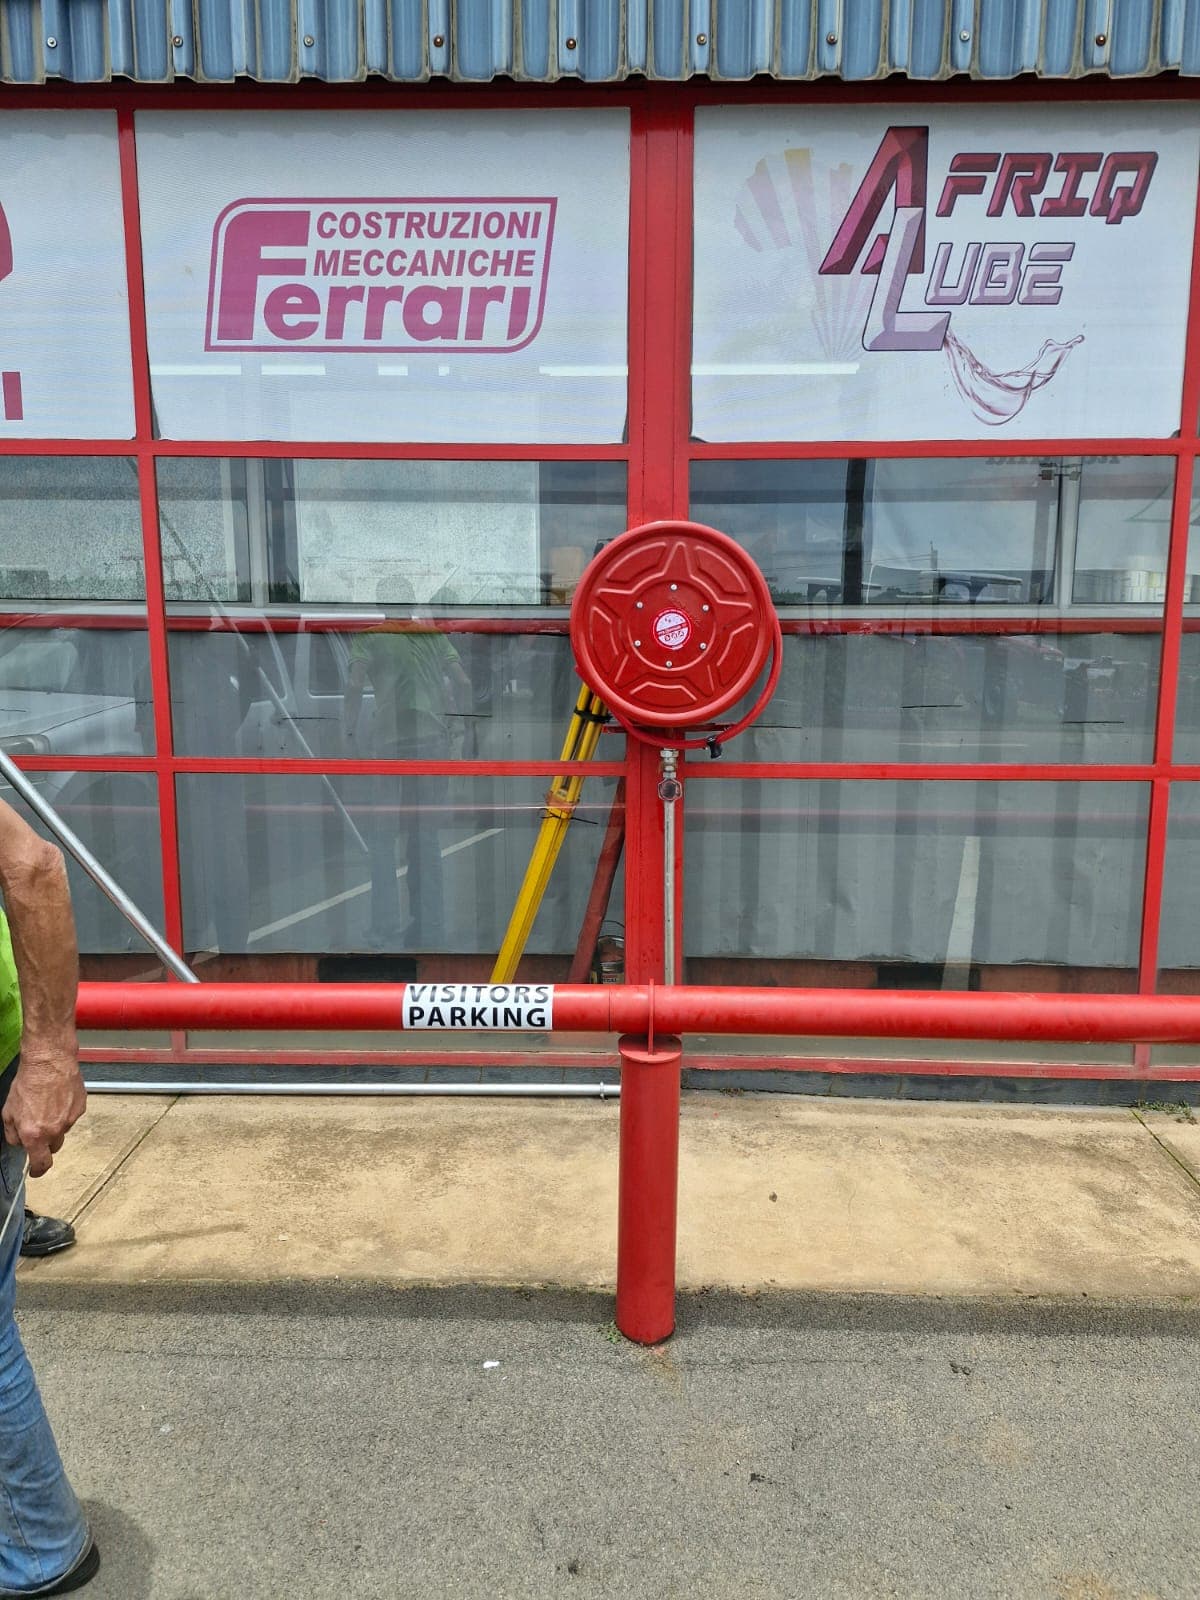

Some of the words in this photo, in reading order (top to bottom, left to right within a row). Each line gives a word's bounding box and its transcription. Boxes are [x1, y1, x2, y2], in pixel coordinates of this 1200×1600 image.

[819, 126, 1158, 275] AFRIQ
[316, 211, 542, 239] COSTRUZIONI
[217, 211, 531, 341] Ferrari
[313, 249, 534, 276] MECCANICHE
[862, 207, 1075, 351] LUBE
[409, 985, 549, 1004] VISITORS
[409, 1006, 546, 1027] PARKING
